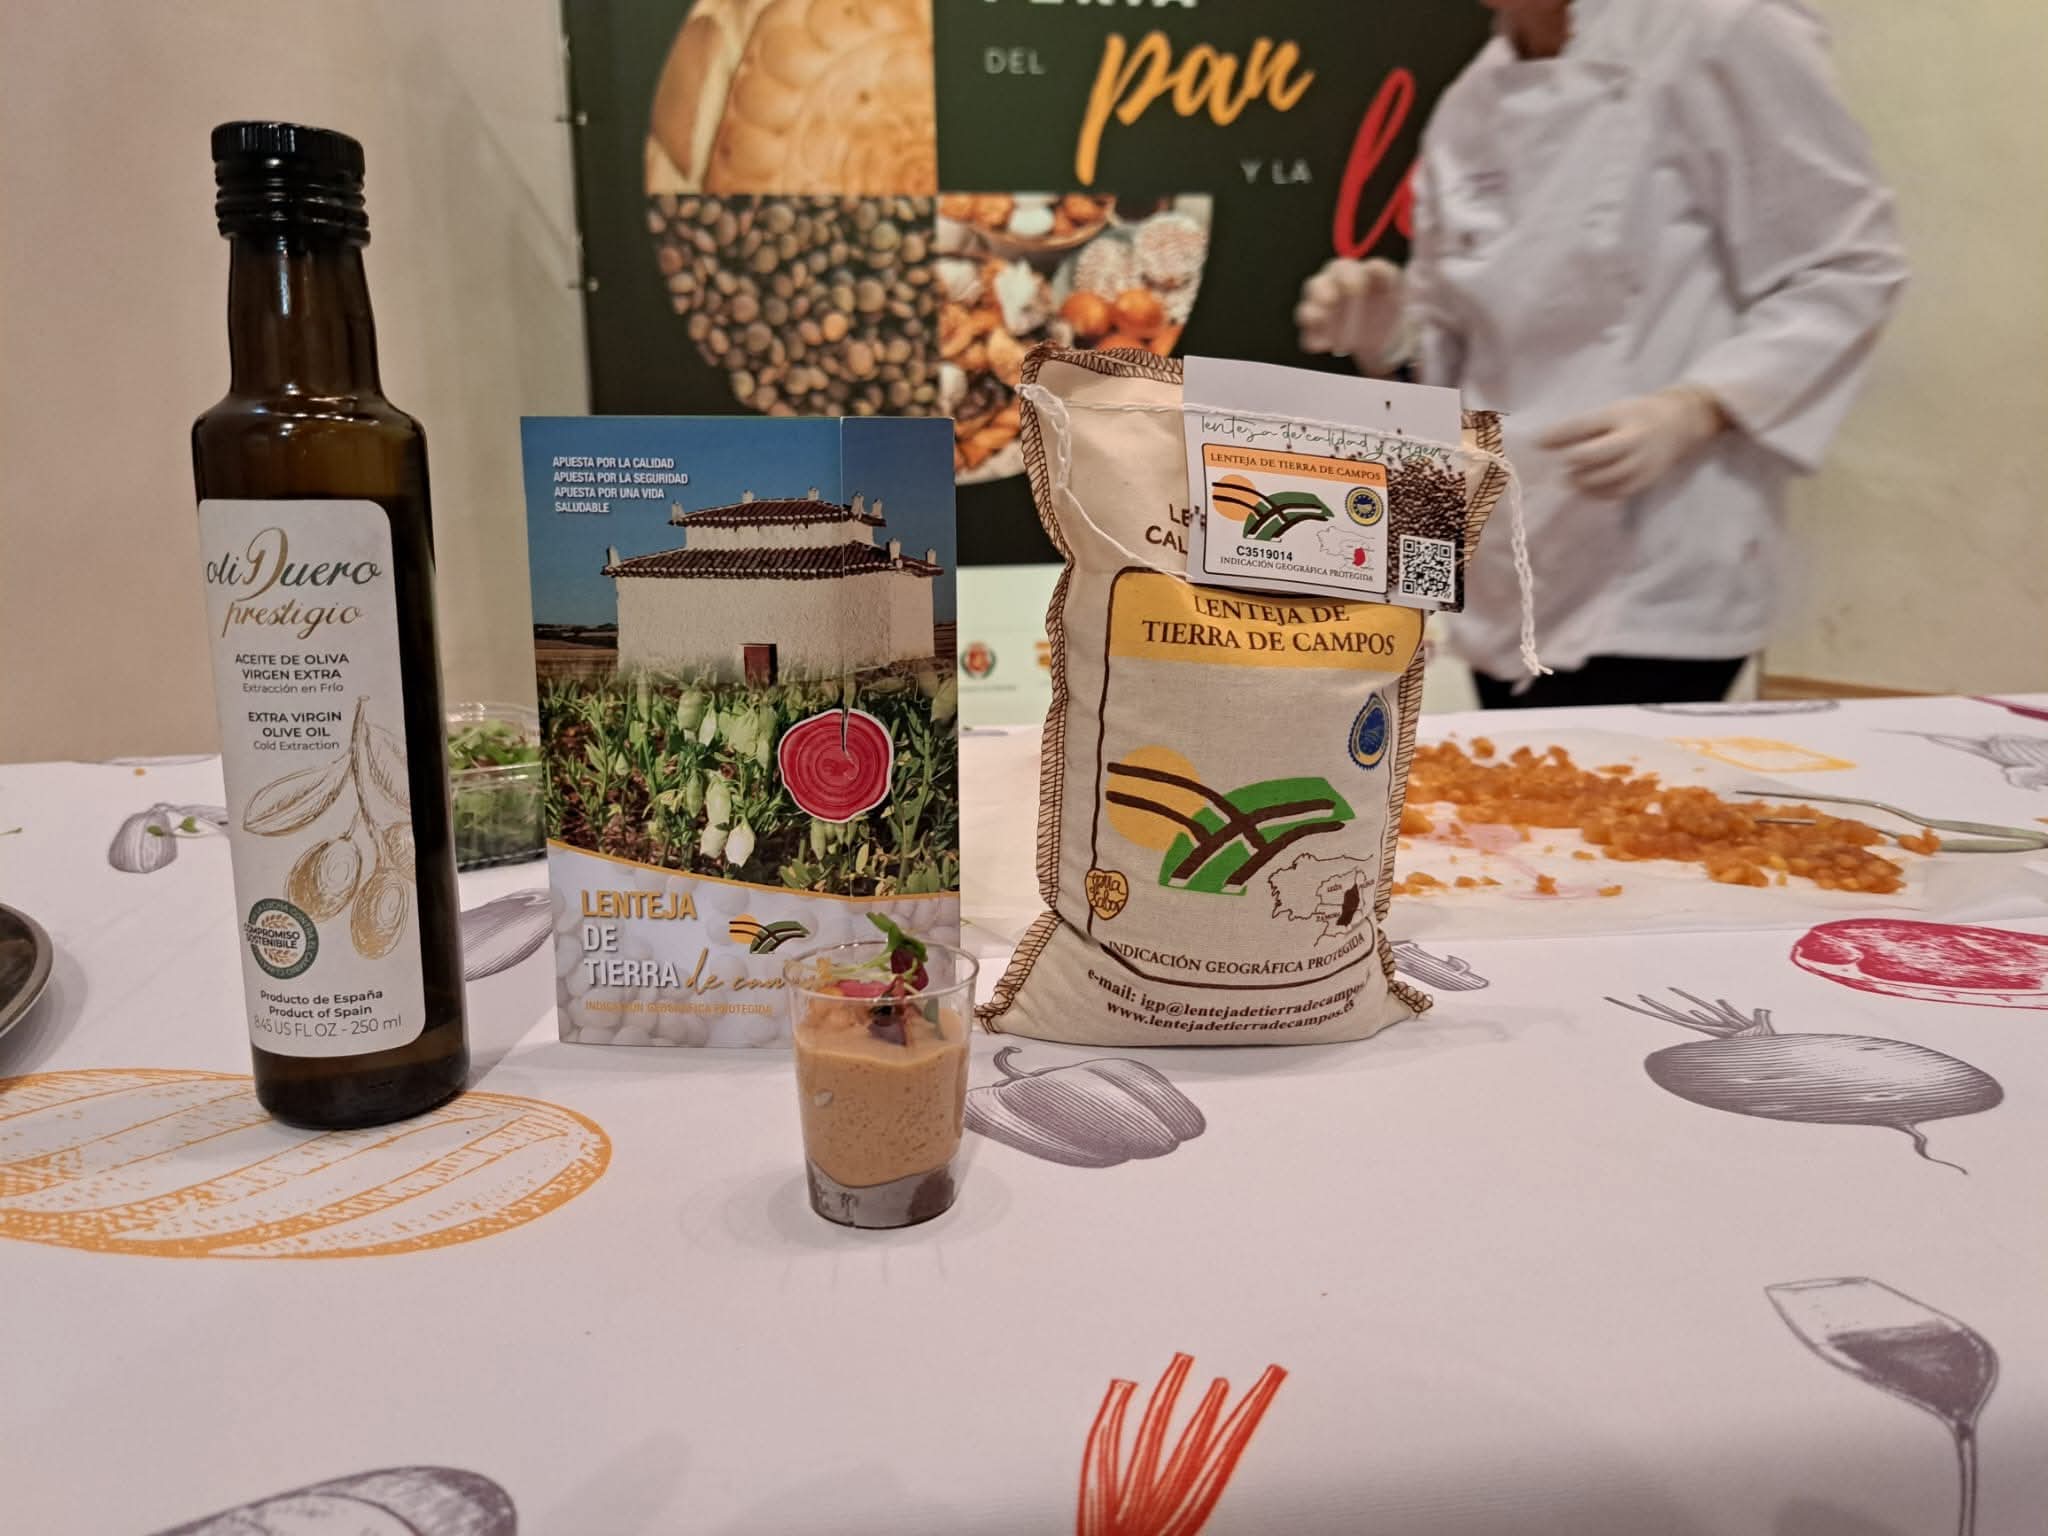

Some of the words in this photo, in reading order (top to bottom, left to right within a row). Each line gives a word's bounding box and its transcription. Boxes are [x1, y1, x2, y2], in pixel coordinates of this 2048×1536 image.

[983, 47, 1045, 75] DEL
[1074, 30, 1315, 186] pan
[1241, 161, 1263, 183] Y
[1271, 160, 1312, 184] LA
[552, 457, 594, 467] APUESTA
[597, 458, 616, 468] POR
[618, 458, 630, 468] LA
[632, 458, 675, 468] CALIDAD
[1210, 452, 1257, 467] LENTEJA
[1259, 458, 1277, 468] DE
[1280, 461, 1317, 475] TIERRA
[1319, 466, 1335, 476] DE
[1336, 468, 1382, 482] CAMPOS
[553, 472, 595, 483] APUESTA
[597, 473, 616, 483] POR
[619, 474, 631, 483] LA
[633, 474, 688, 485] SEGURIDAD
[554, 488, 596, 498] APUESTA
[598, 488, 617, 498] POR
[619, 489, 639, 498] UNA
[641, 489, 665, 499] VIDA
[555, 503, 610, 513] SALUDABLE
[1236, 545, 1293, 562] C3519014
[1220, 556, 1274, 570] INDICACIÓN
[1275, 563, 1328, 576] GEOGRÁFICA
[1329, 569, 1374, 582] PROTEGIDA
[222, 599, 364, 640] prestigio
[1194, 595, 1308, 627] LENTEJA
[1311, 604, 1350, 622] DE
[1141, 620, 1242, 650] TIERRA
[1247, 631, 1287, 651] DE
[1292, 631, 1396, 656] CAMPOS
[235, 654, 277, 665] ACEITE
[280, 654, 300, 665] DE
[304, 653, 350, 665] OLIVA
[242, 669, 290, 681] VIRGEN
[294, 669, 342, 679] EXTRA
[242, 682, 298, 694] Extracción
[301, 685, 317, 693] en
[320, 682, 344, 693] Frío
[248, 711, 289, 722] EXTRA
[291, 711, 342, 722] VIRGIN
[262, 727, 303, 738] OLIVE
[306, 726, 331, 738] OIL
[253, 740, 277, 751] Cold
[279, 740, 340, 751] Extraction
[581, 889, 697, 920] LENTEJA
[583, 924, 618, 951] DE
[1107, 941, 1202, 971] INDICACIÓN
[1206, 960, 1303, 975] GEOGRÁFICA
[1307, 932, 1365, 970] PROTEGIDA
[584, 958, 680, 988] TIERRA
[685, 947, 724, 996] de
[1088, 969, 1136, 1002] e-mail:
[260, 990, 308, 1005] Producto
[312, 994, 330, 1005] de
[334, 989, 383, 1004] España
[269, 1005, 314, 1018] Product
[318, 1005, 331, 1018] of
[334, 1005, 373, 1019] Spain
[1107, 1000, 1355, 1032] www.lentejadetierradecampos.es
[274, 1021, 292, 1037] US
[295, 1023, 312, 1037] FL
[315, 1022, 338, 1037] OZ
[350, 1018, 379, 1036] 250
[382, 1015, 402, 1030] ml
